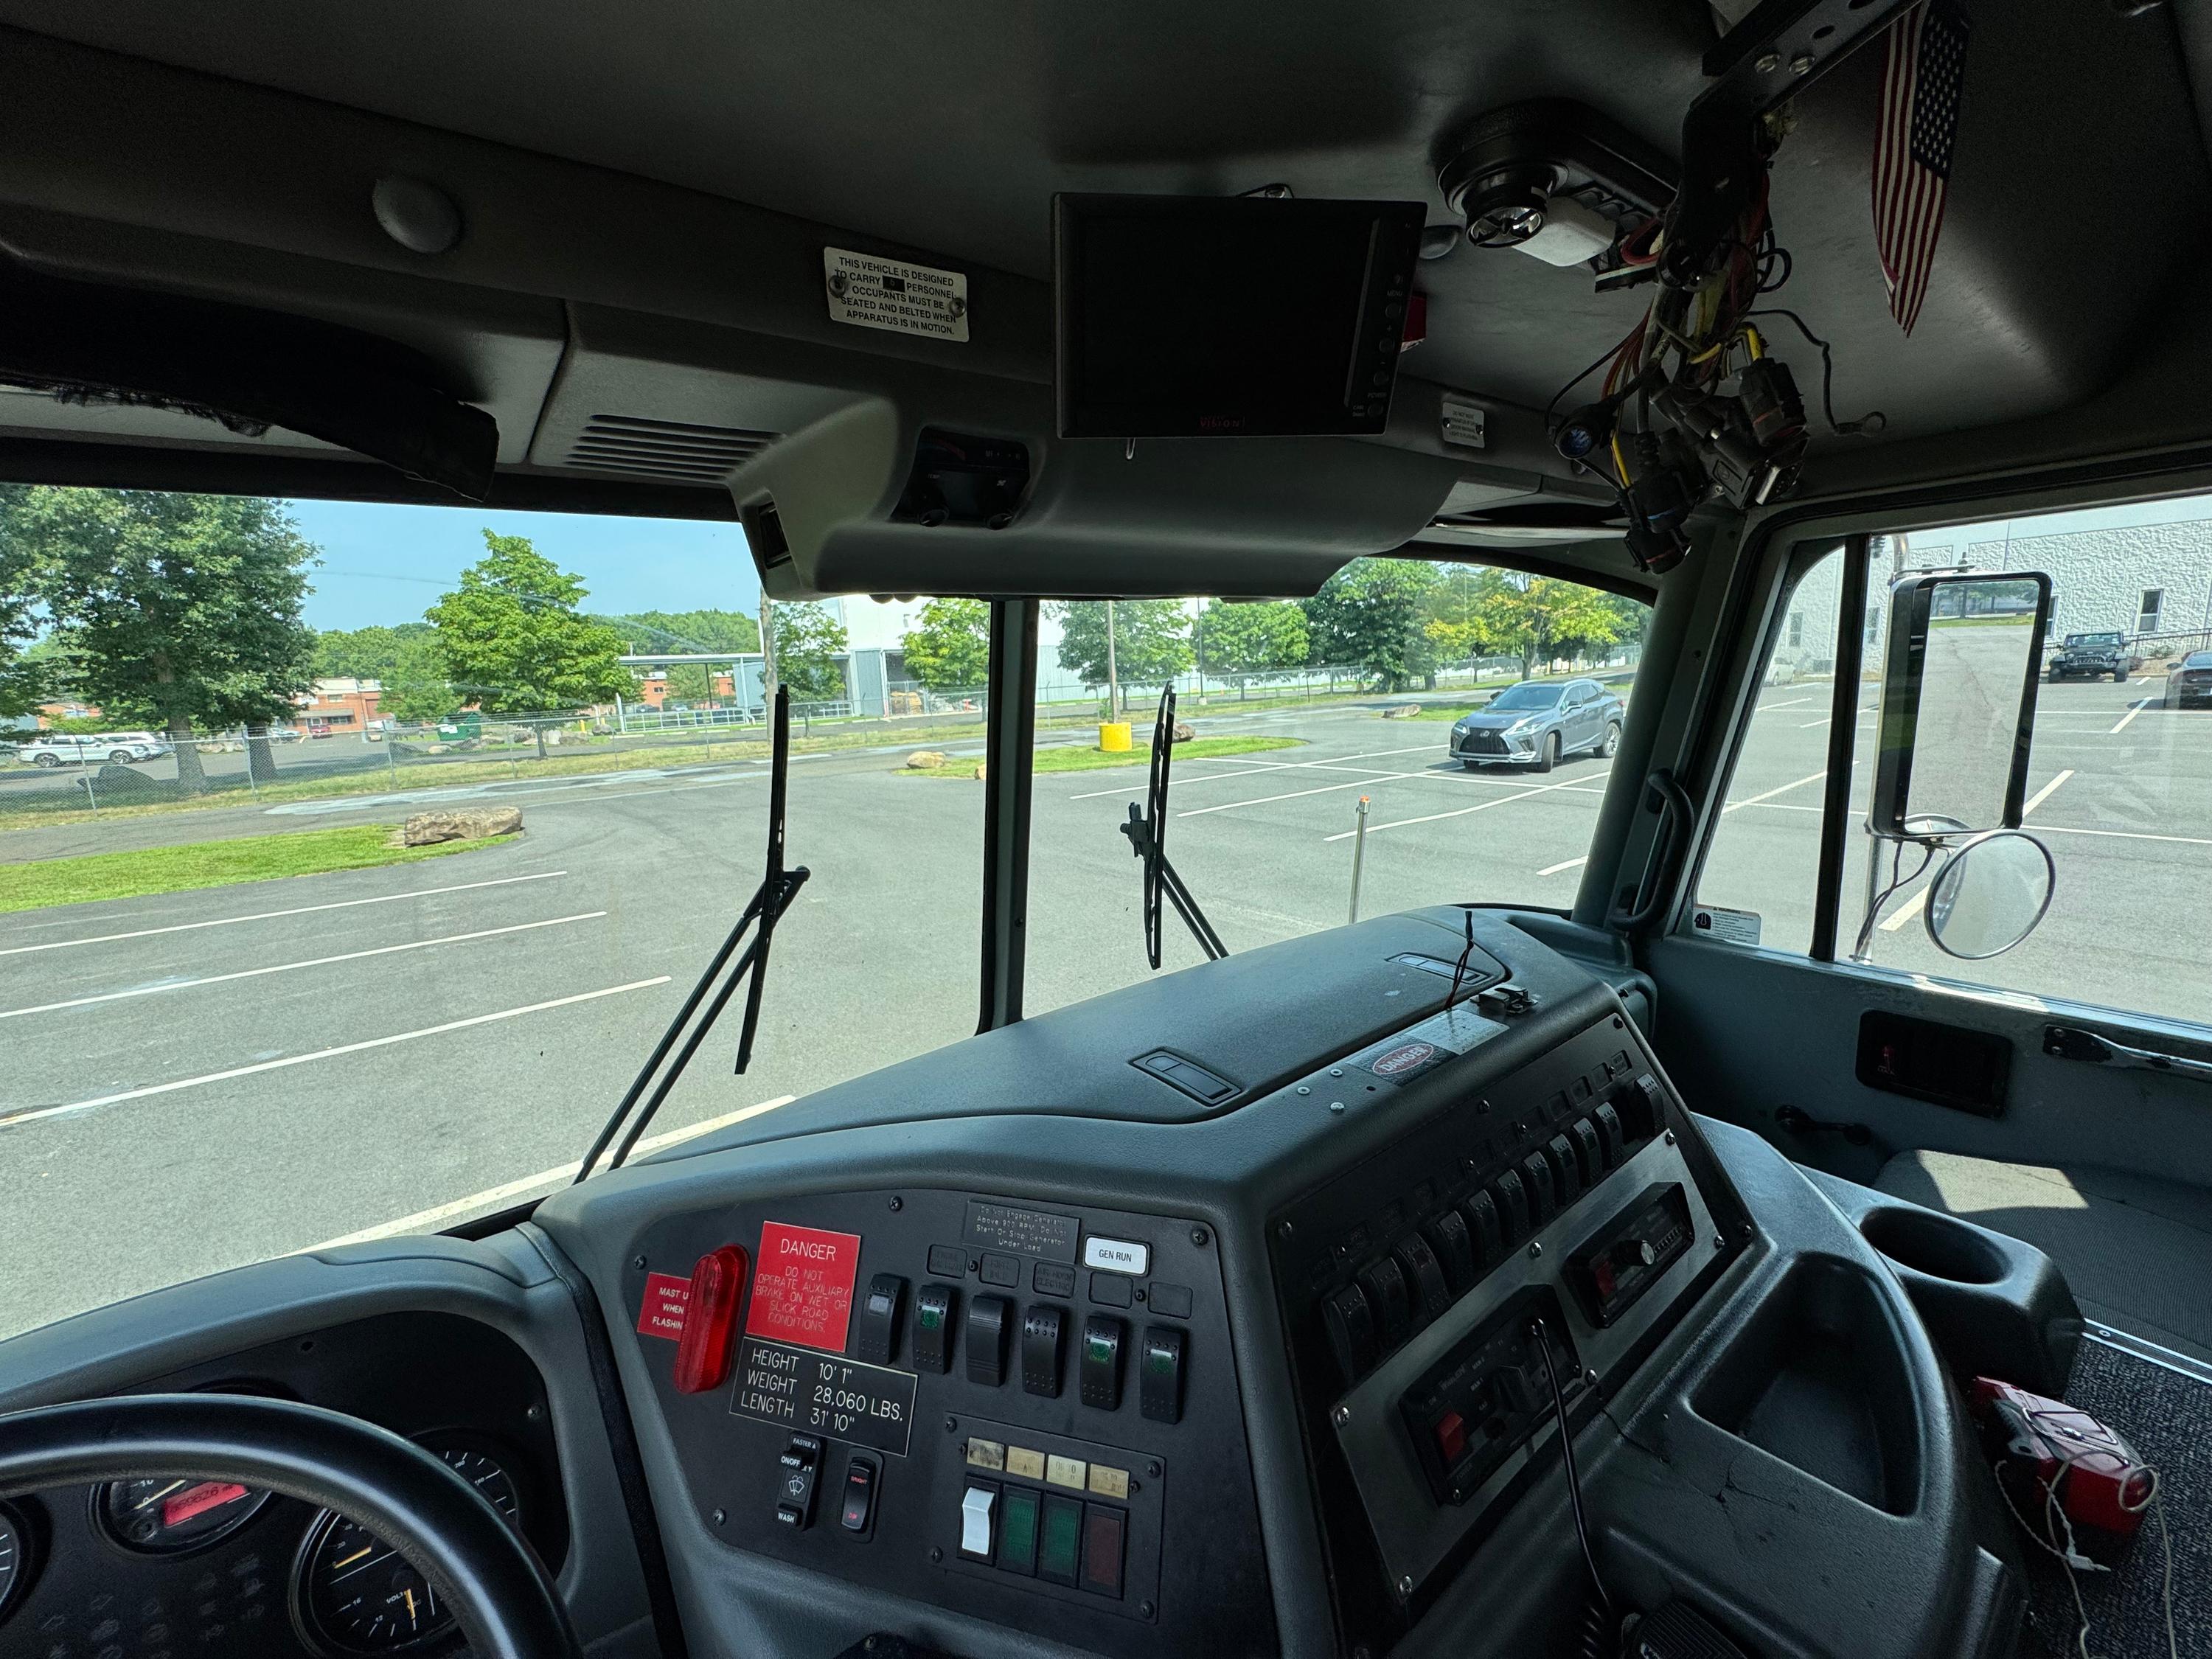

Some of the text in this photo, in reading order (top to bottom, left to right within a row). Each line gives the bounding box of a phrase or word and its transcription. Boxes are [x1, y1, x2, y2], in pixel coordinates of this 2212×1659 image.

[839, 257, 954, 287] THIS VEHICLE IS DESIGNED
[835, 268, 847, 279] TO
[849, 272, 880, 285] CARRY
[906, 282, 956, 299] PERSONNEL
[852, 285, 945, 310] OCCUPANTS MUST BE
[841, 296, 956, 324] SEATED AND BELTED WHEN
[846, 310, 955, 335] APPARATUS IS IN MOTION.
[1380, 1046, 1427, 1071] DANGER
[977, 1216, 999, 1225] Above
[1040, 1225, 1050, 1234] Do
[1006, 1210, 1030, 1221] Engage
[976, 1224, 994, 1233] Start
[1009, 1230, 1026, 1239] Stop
[1029, 1234, 1065, 1245] Generator
[998, 1238, 1042, 1252] Under Load
[780, 1238, 836, 1262] DANGER
[1099, 1249, 1132, 1262] GEN RUN
[785, 1266, 824, 1281] DO NOT
[659, 1287, 689, 1300] MAST U
[758, 1273, 849, 1298] OPERATE AUXILIARY
[663, 1303, 684, 1314] WHEN
[756, 1285, 847, 1312] BRAKE ON WET OR
[770, 1300, 828, 1321] SLICK ROAD
[652, 1316, 684, 1330] FLASHIN
[752, 1348, 799, 1372] HEIGHT
[819, 1363, 837, 1380] 10'
[748, 1368, 903, 1422] WEIGHT 28,060 LBS.
[741, 1391, 795, 1419] LENGTH
[810, 1407, 829, 1427] 31'
[793, 1438, 812, 1448] FASTER
[778, 1512, 795, 1523] WASH
